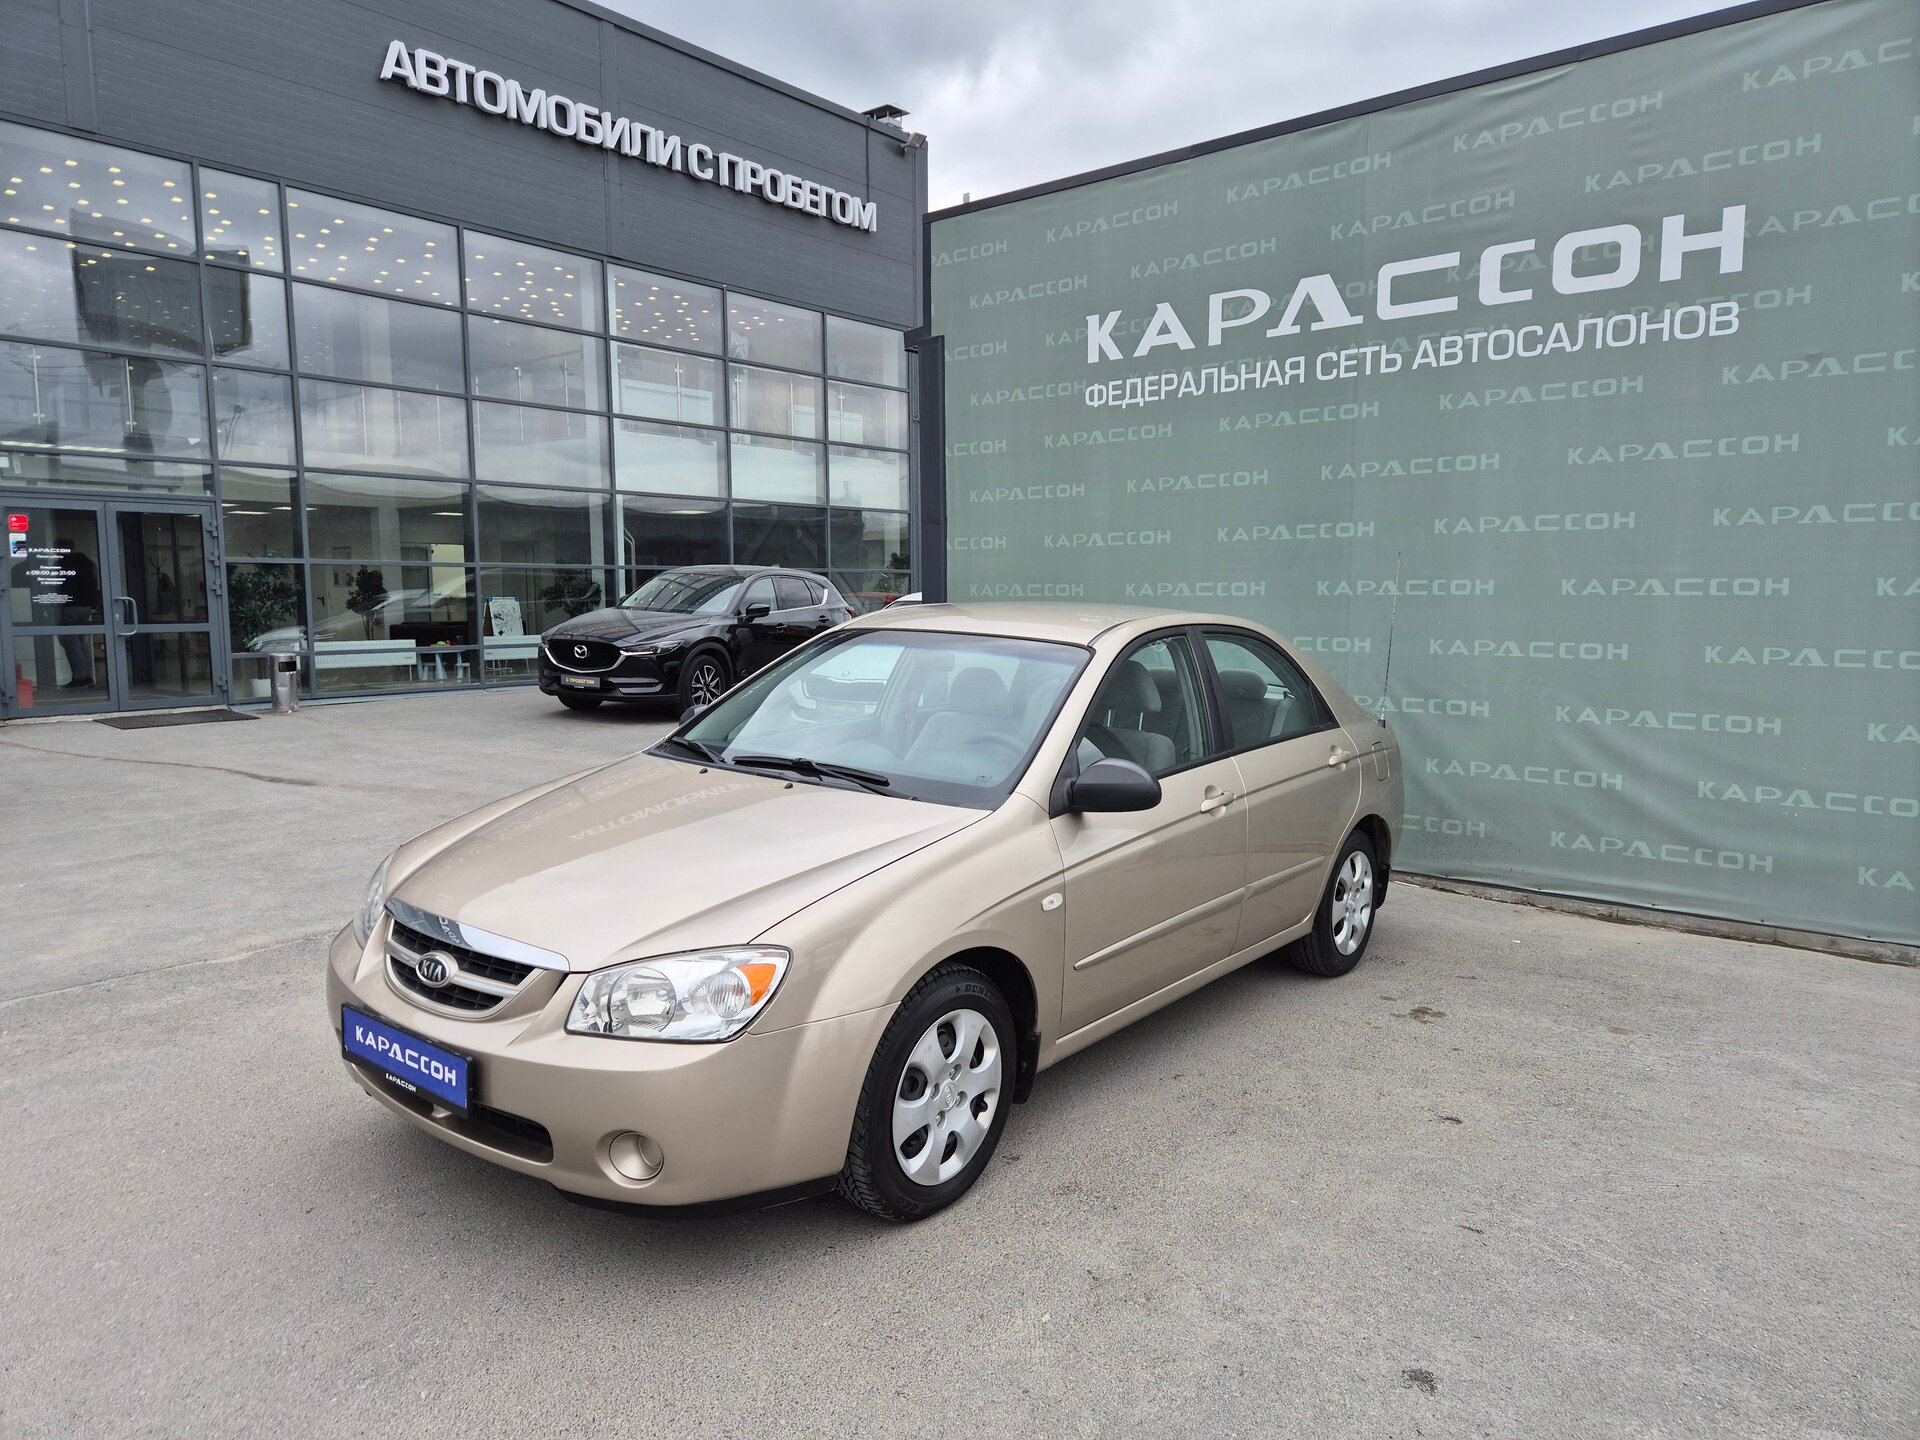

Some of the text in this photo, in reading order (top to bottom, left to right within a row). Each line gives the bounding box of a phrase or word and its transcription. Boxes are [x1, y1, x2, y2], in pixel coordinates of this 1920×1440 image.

[380, 39, 877, 232] АВТОМОБИЛИ С ПРОБЕГОМ
[1085, 300, 1739, 409] ФЕДЕРАЛЬНАЯ СЕТЬ АВТОСАЛОНОВ
[420, 959, 443, 981] KIA
